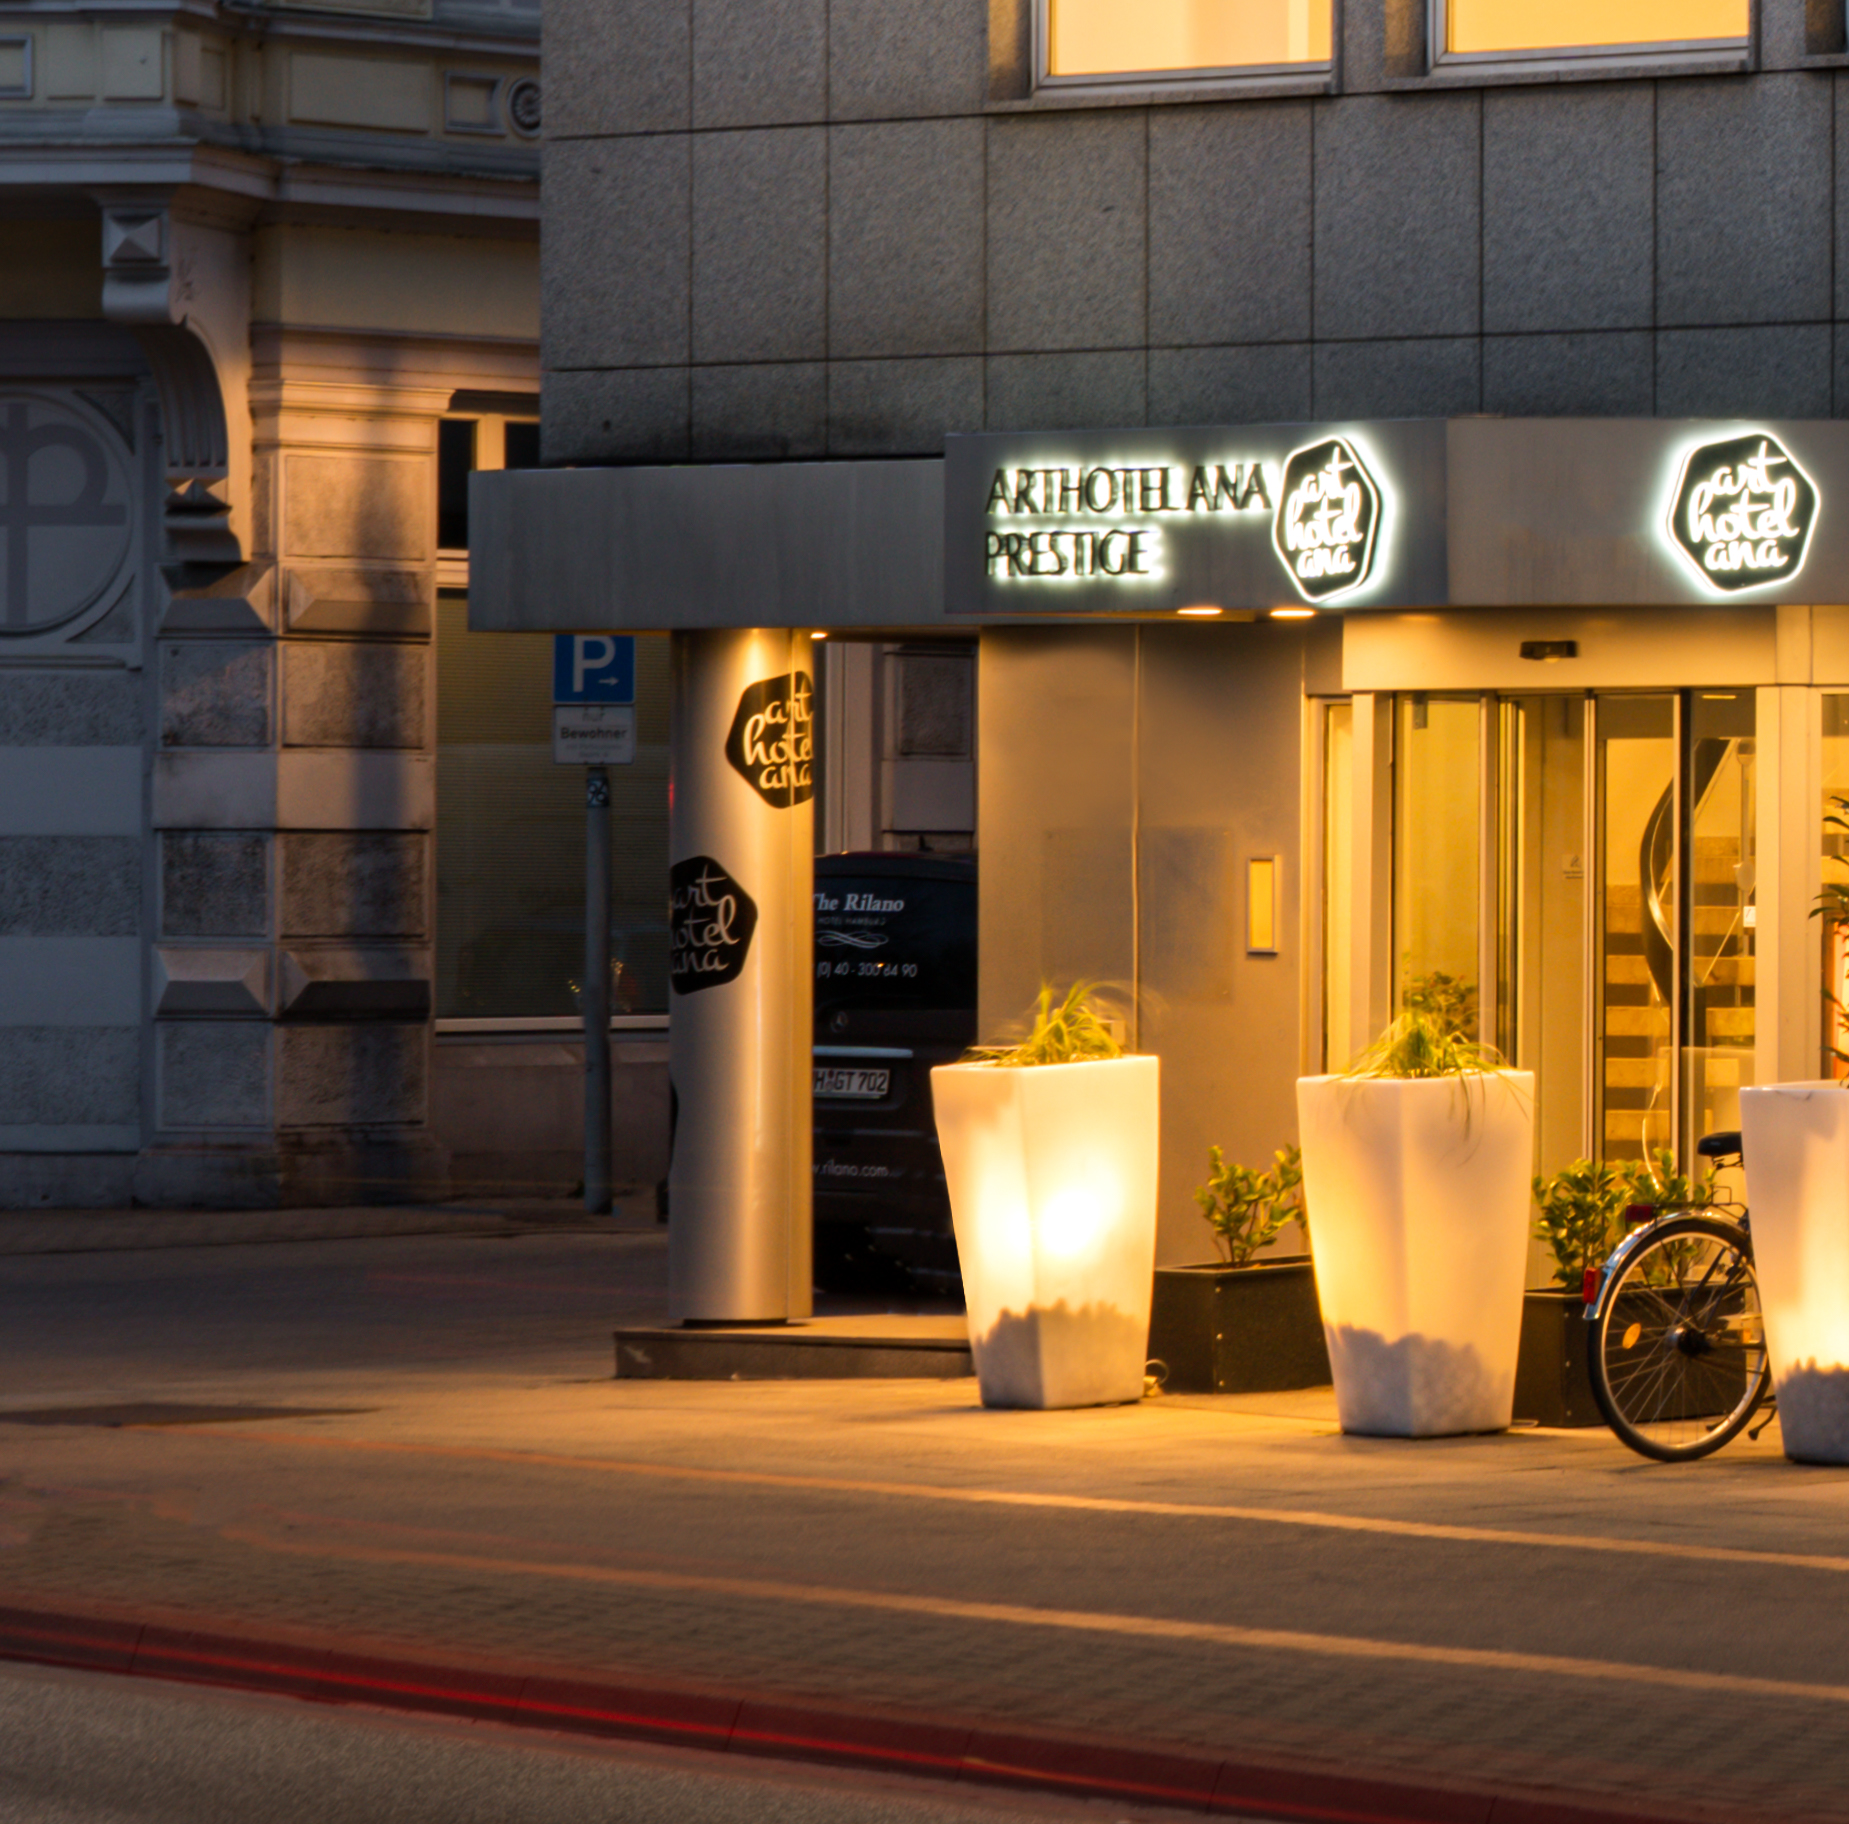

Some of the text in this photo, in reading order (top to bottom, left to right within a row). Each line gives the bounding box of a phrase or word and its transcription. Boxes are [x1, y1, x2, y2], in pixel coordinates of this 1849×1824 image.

[986, 462, 1273, 514] ARTHOTEL ANA
[1300, 445, 1354, 503] art
[1709, 440, 1788, 496] art
[1284, 482, 1364, 552] hotel
[1688, 477, 1801, 544] hotel
[985, 529, 1152, 577] PRESTIGE
[1296, 544, 1357, 578] ana
[1704, 539, 1789, 571] ana
[573, 635, 616, 693] P
[764, 678, 813, 724] art
[560, 727, 628, 740] Bewohner
[759, 763, 813, 790] ana
[672, 863, 728, 909] art
[843, 893, 905, 913] Rilano
[671, 894, 742, 950] otel
[901, 963, 918, 978] 90
[858, 1071, 888, 1092] 702
